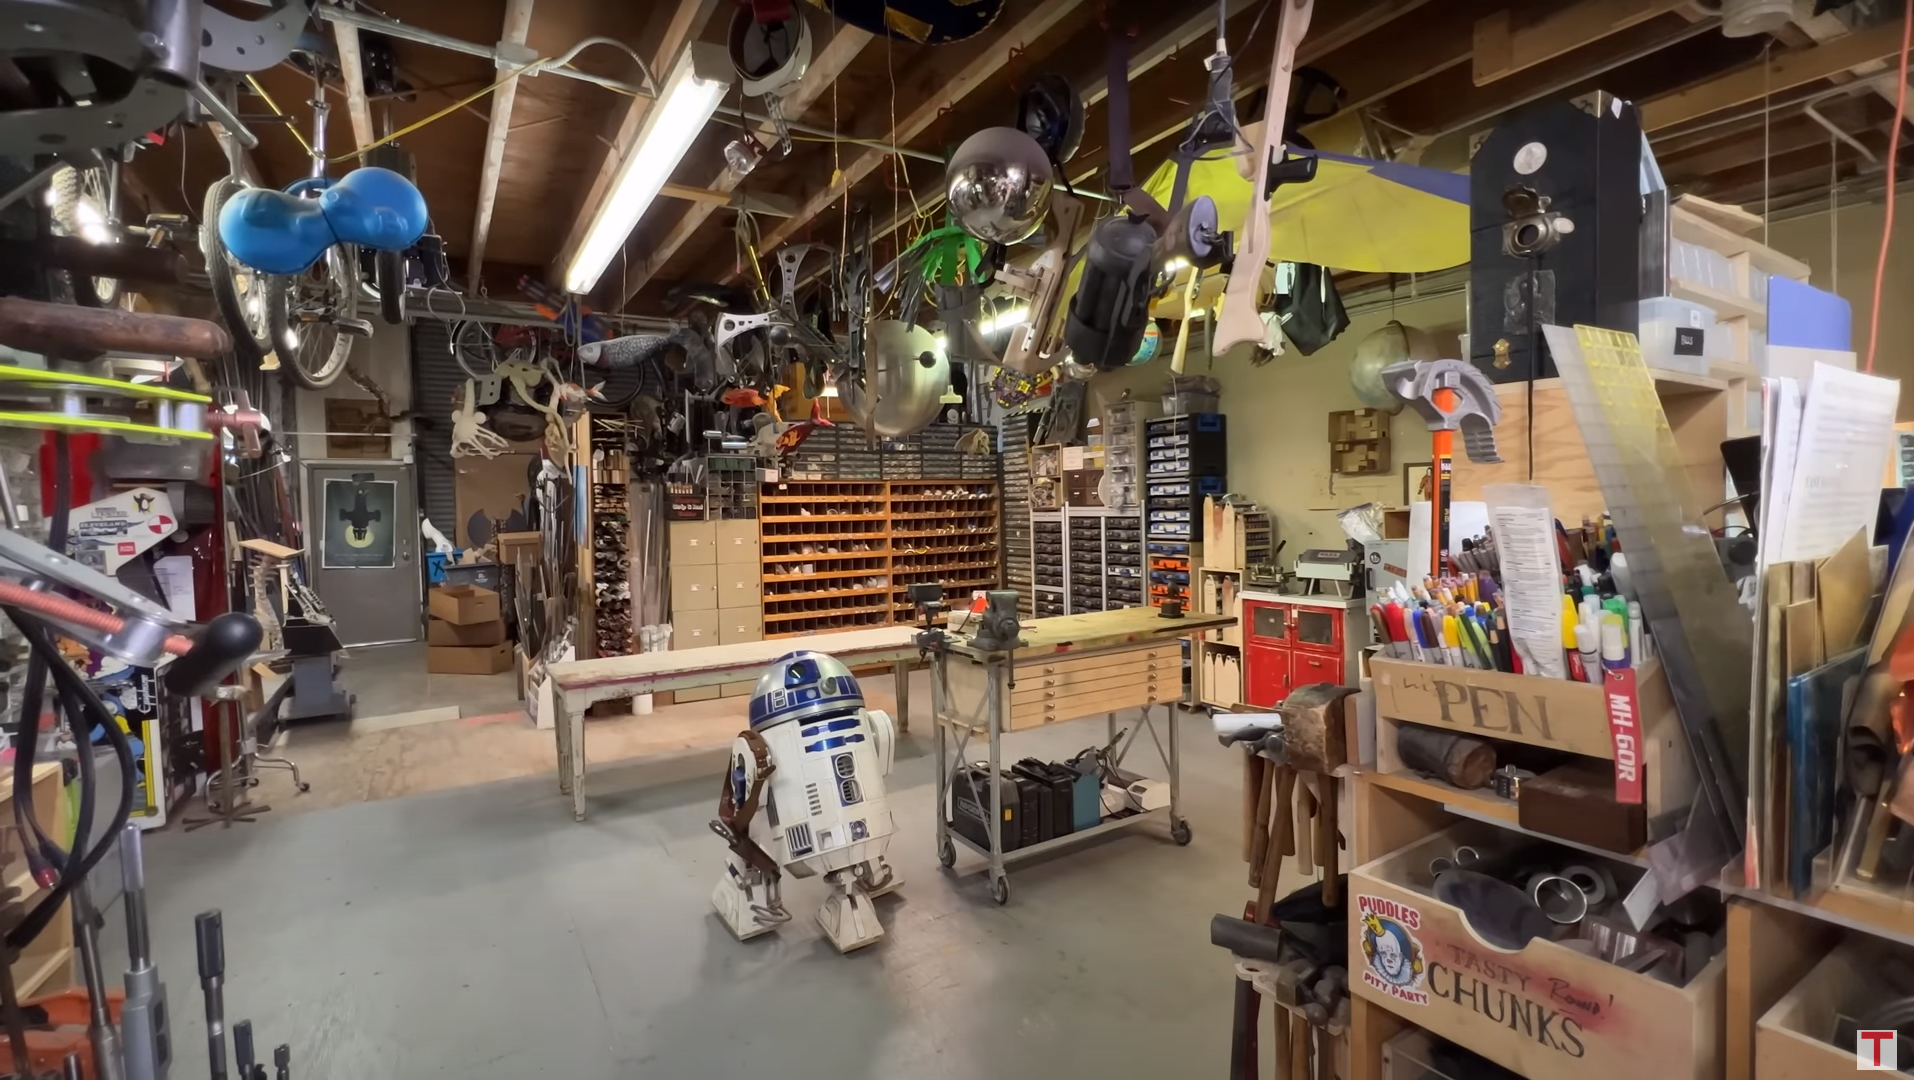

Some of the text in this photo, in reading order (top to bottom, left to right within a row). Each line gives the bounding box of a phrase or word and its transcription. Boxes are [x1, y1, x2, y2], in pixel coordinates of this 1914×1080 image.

[1433, 680, 1554, 741] PEN
[1358, 896, 1420, 929] PUDDLES
[1364, 972, 1428, 1005] PITY PARTY
[1447, 943, 1532, 992] TASTY
[1427, 961, 1585, 1058] CHUNKS
